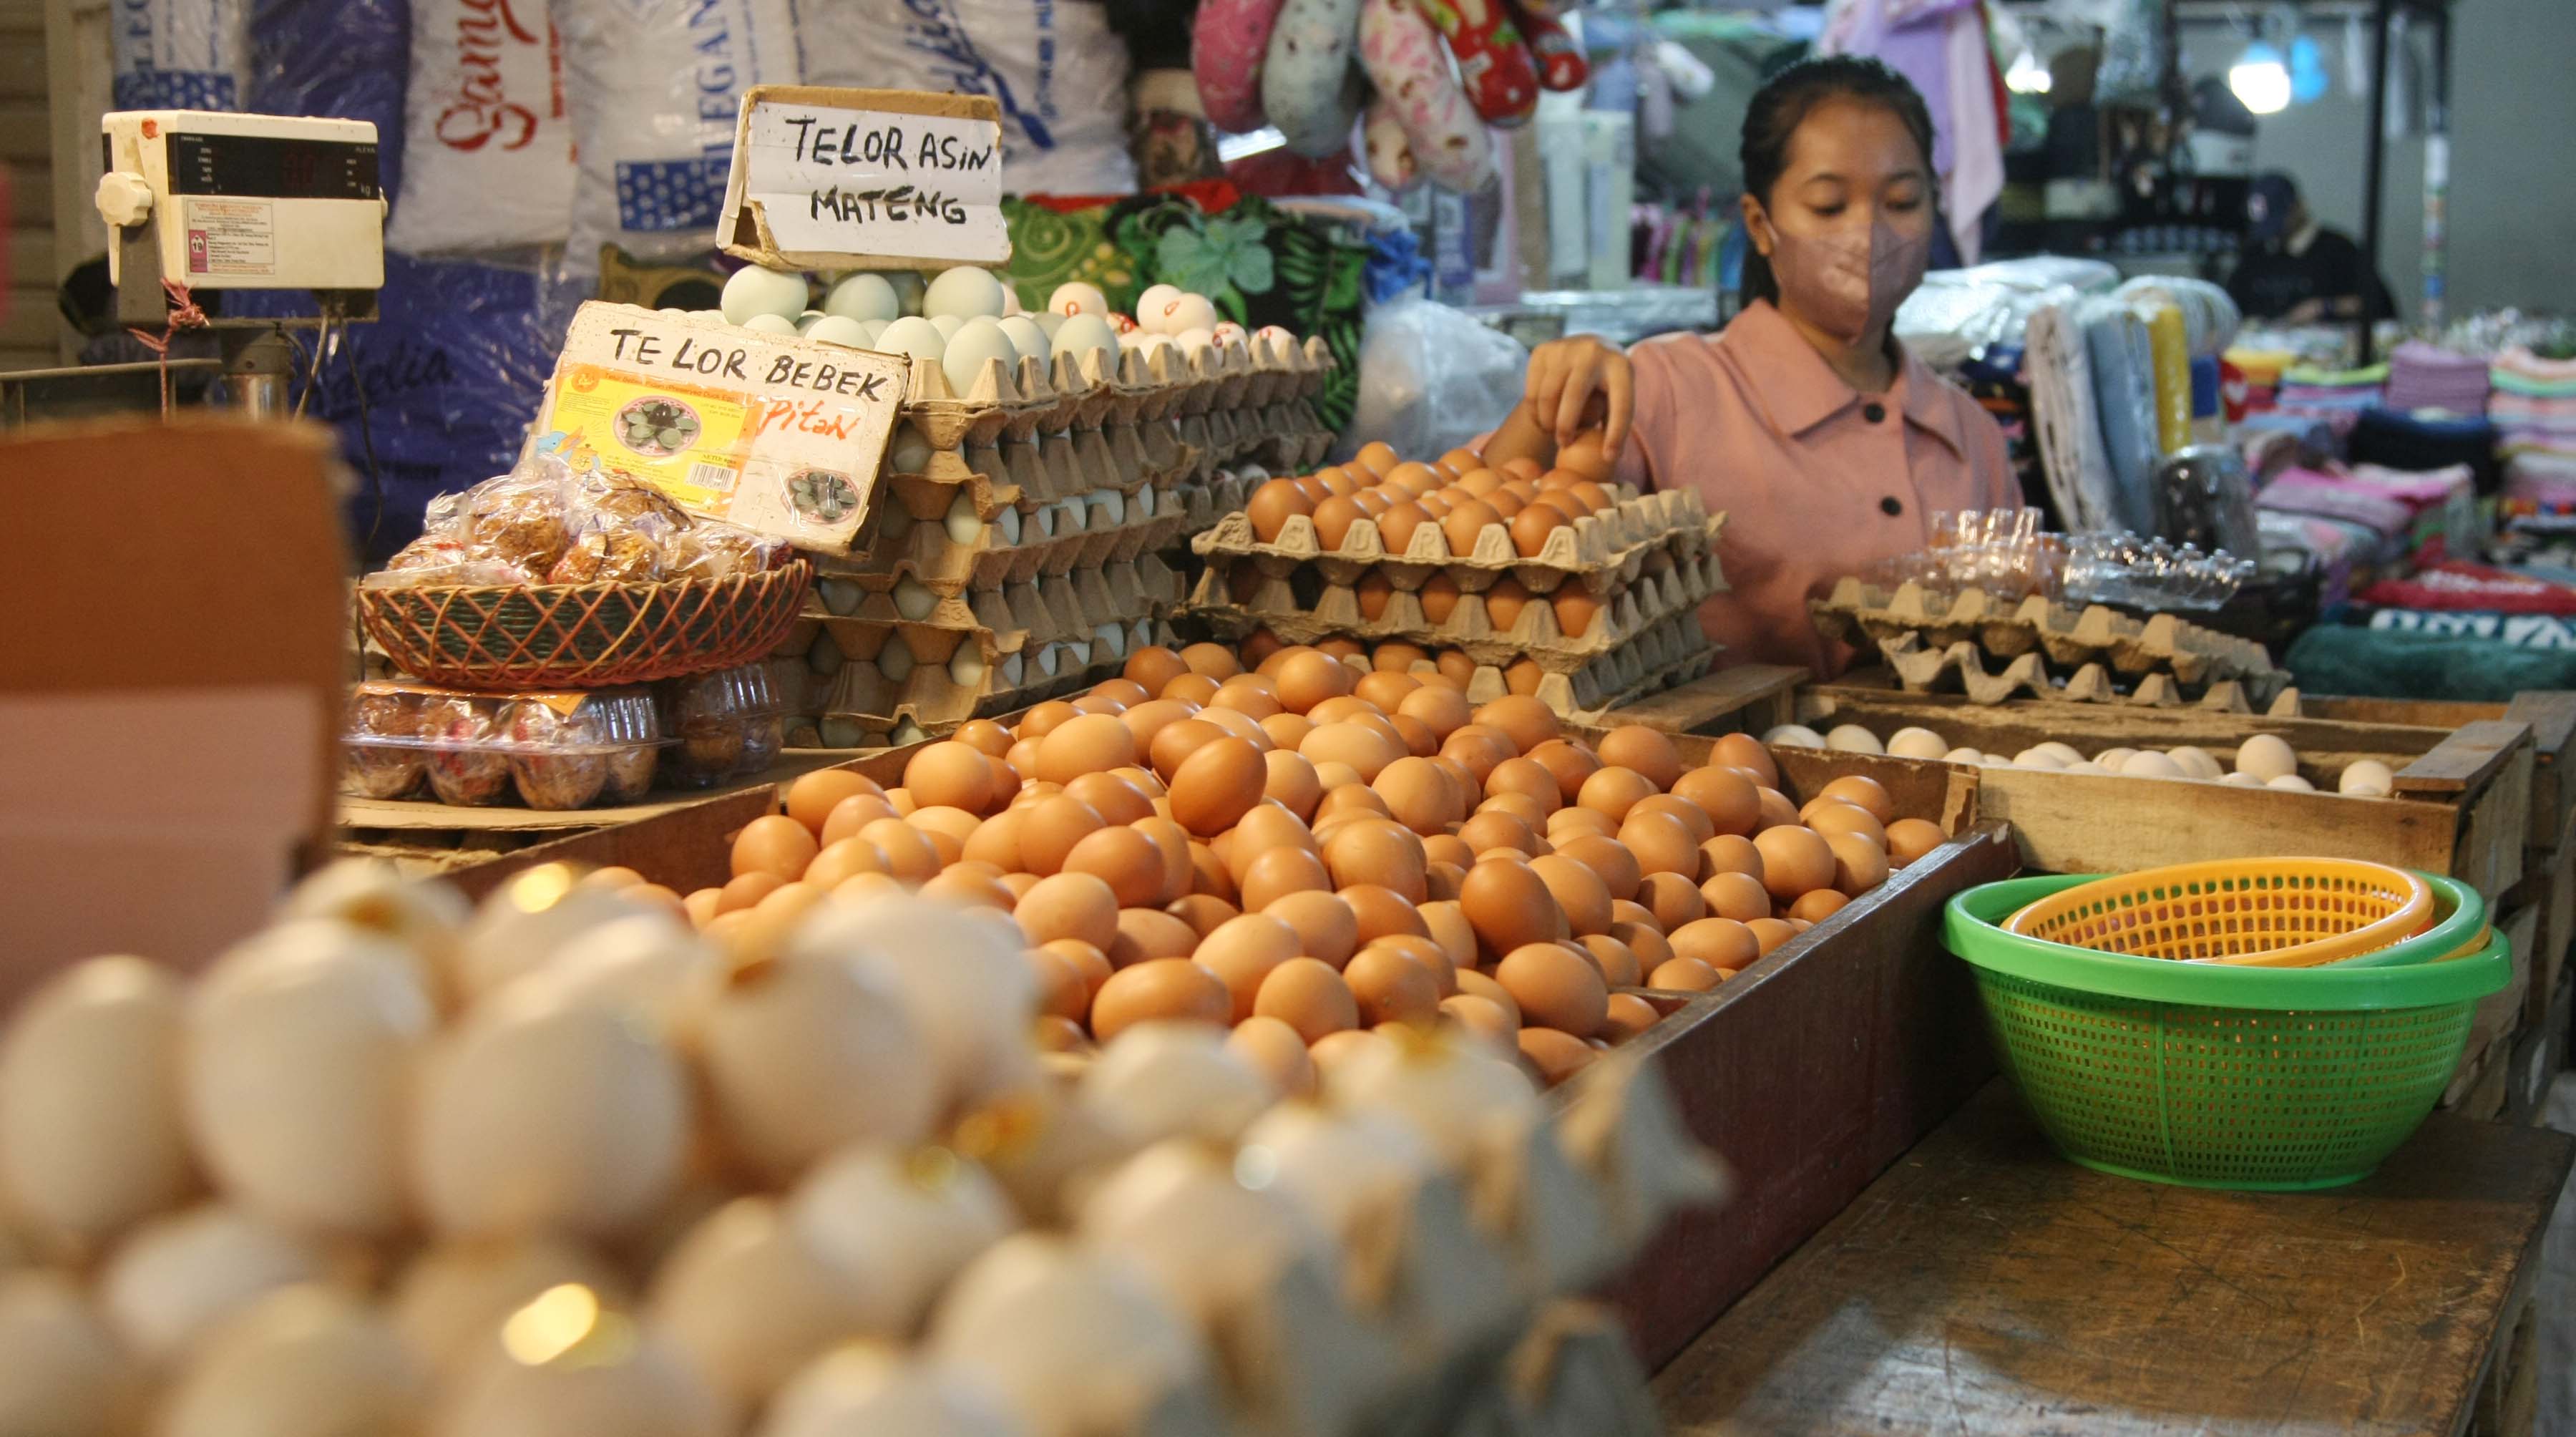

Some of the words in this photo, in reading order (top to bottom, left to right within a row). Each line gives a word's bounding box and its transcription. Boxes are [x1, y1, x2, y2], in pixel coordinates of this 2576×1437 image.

[786, 115, 908, 170] TELOR
[811, 185, 967, 224] MATENG
[764, 355, 888, 402] BEBEK
